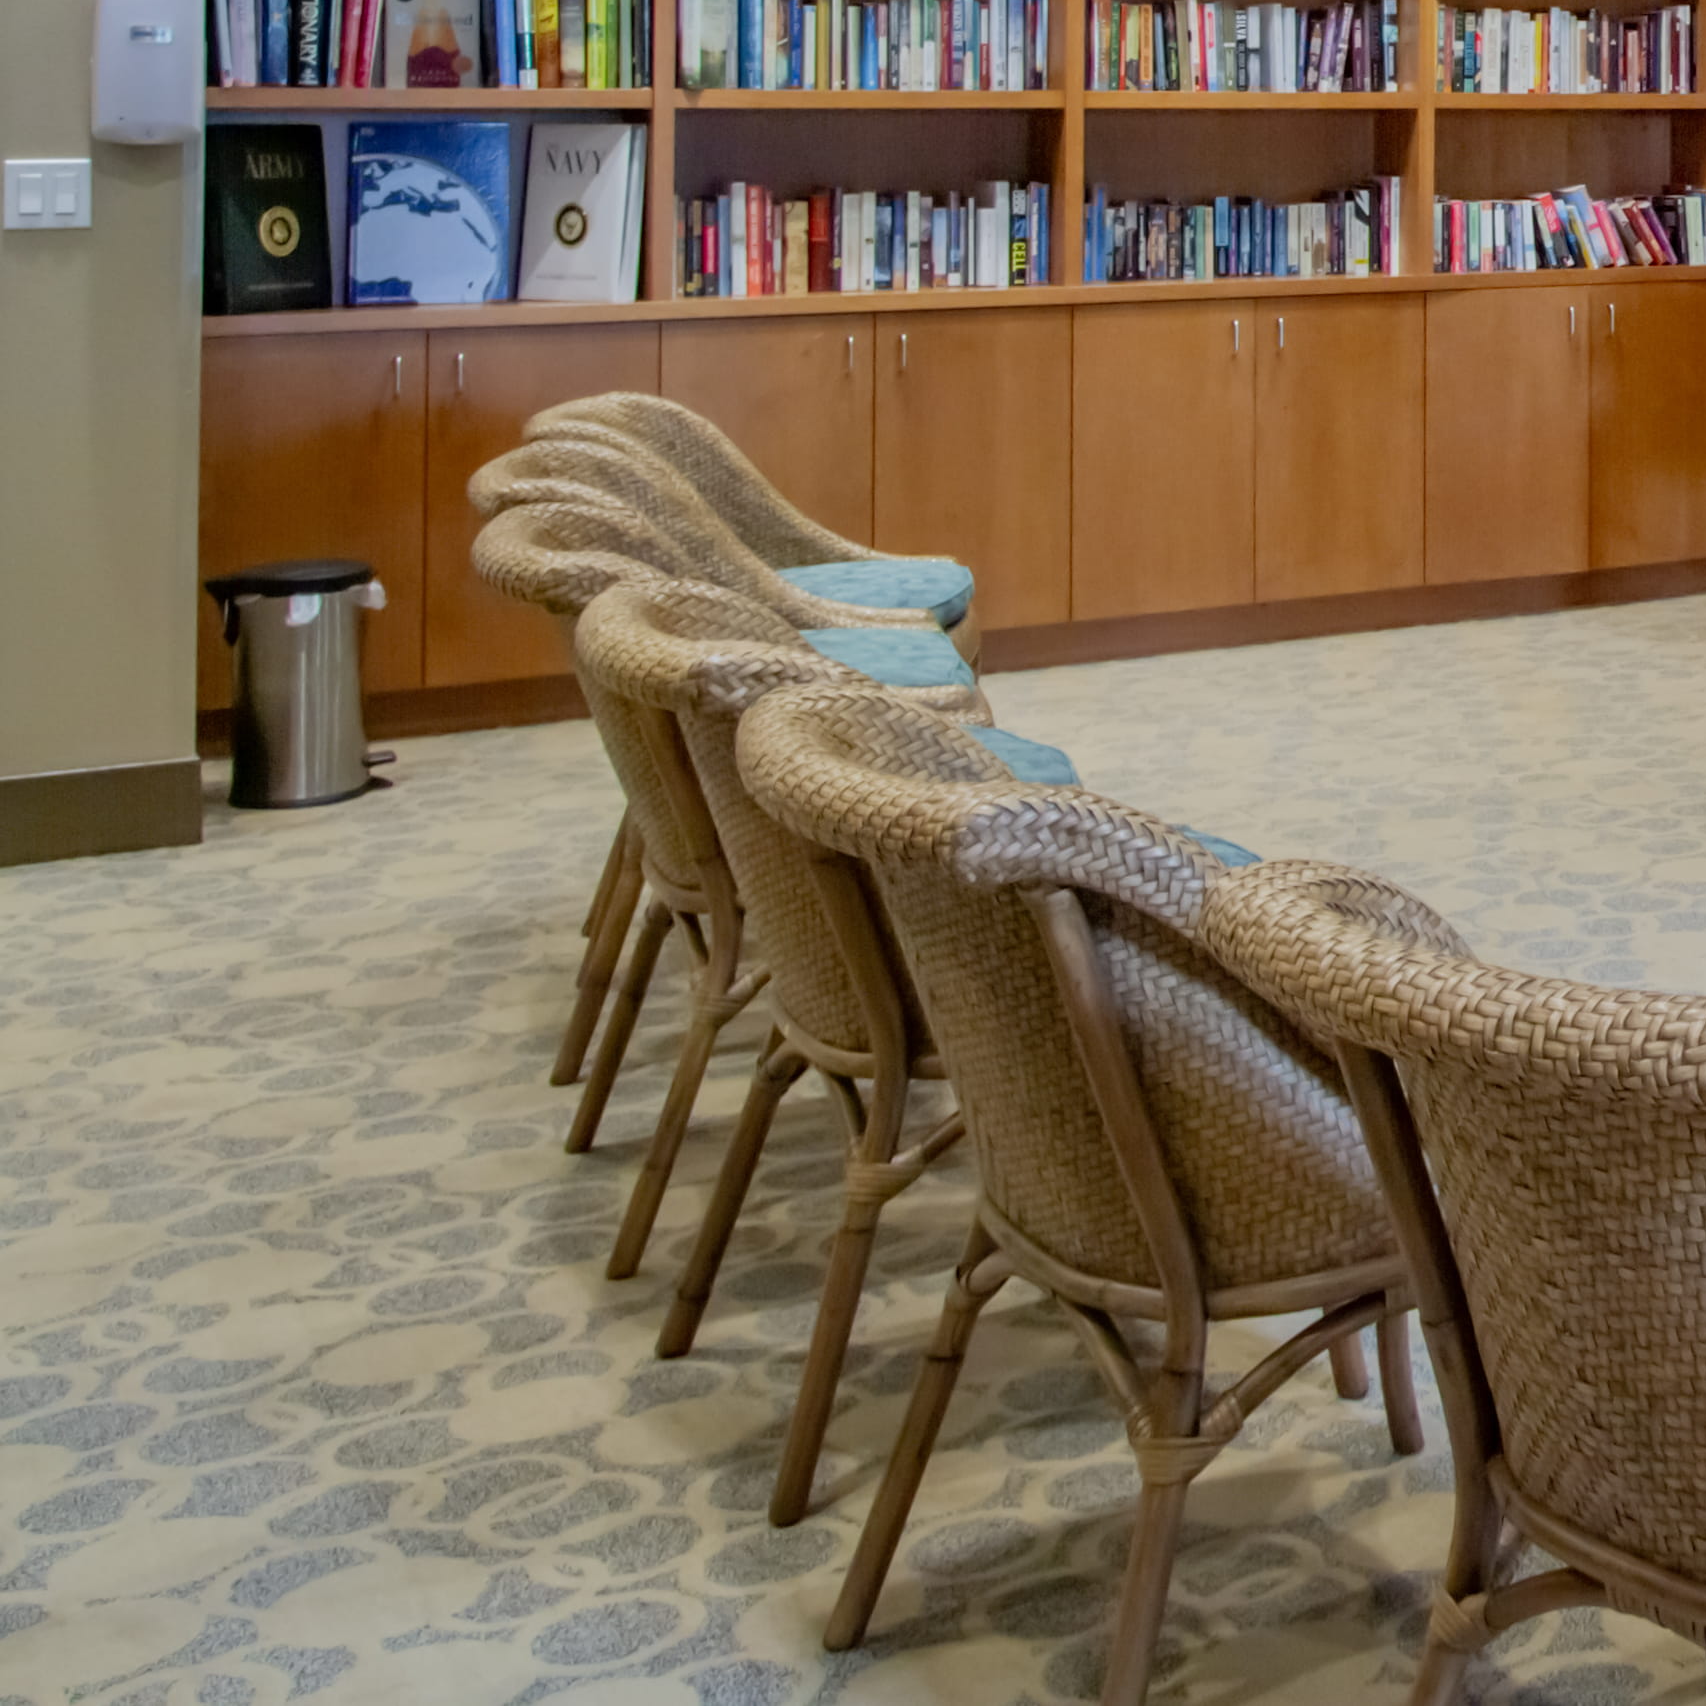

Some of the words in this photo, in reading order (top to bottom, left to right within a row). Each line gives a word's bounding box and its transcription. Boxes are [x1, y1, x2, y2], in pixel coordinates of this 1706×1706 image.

[1236, 14, 1248, 40] SILVA
[243, 153, 307, 180] ARMY
[546, 149, 607, 175] NAVY
[1012, 241, 1027, 273] CELL
